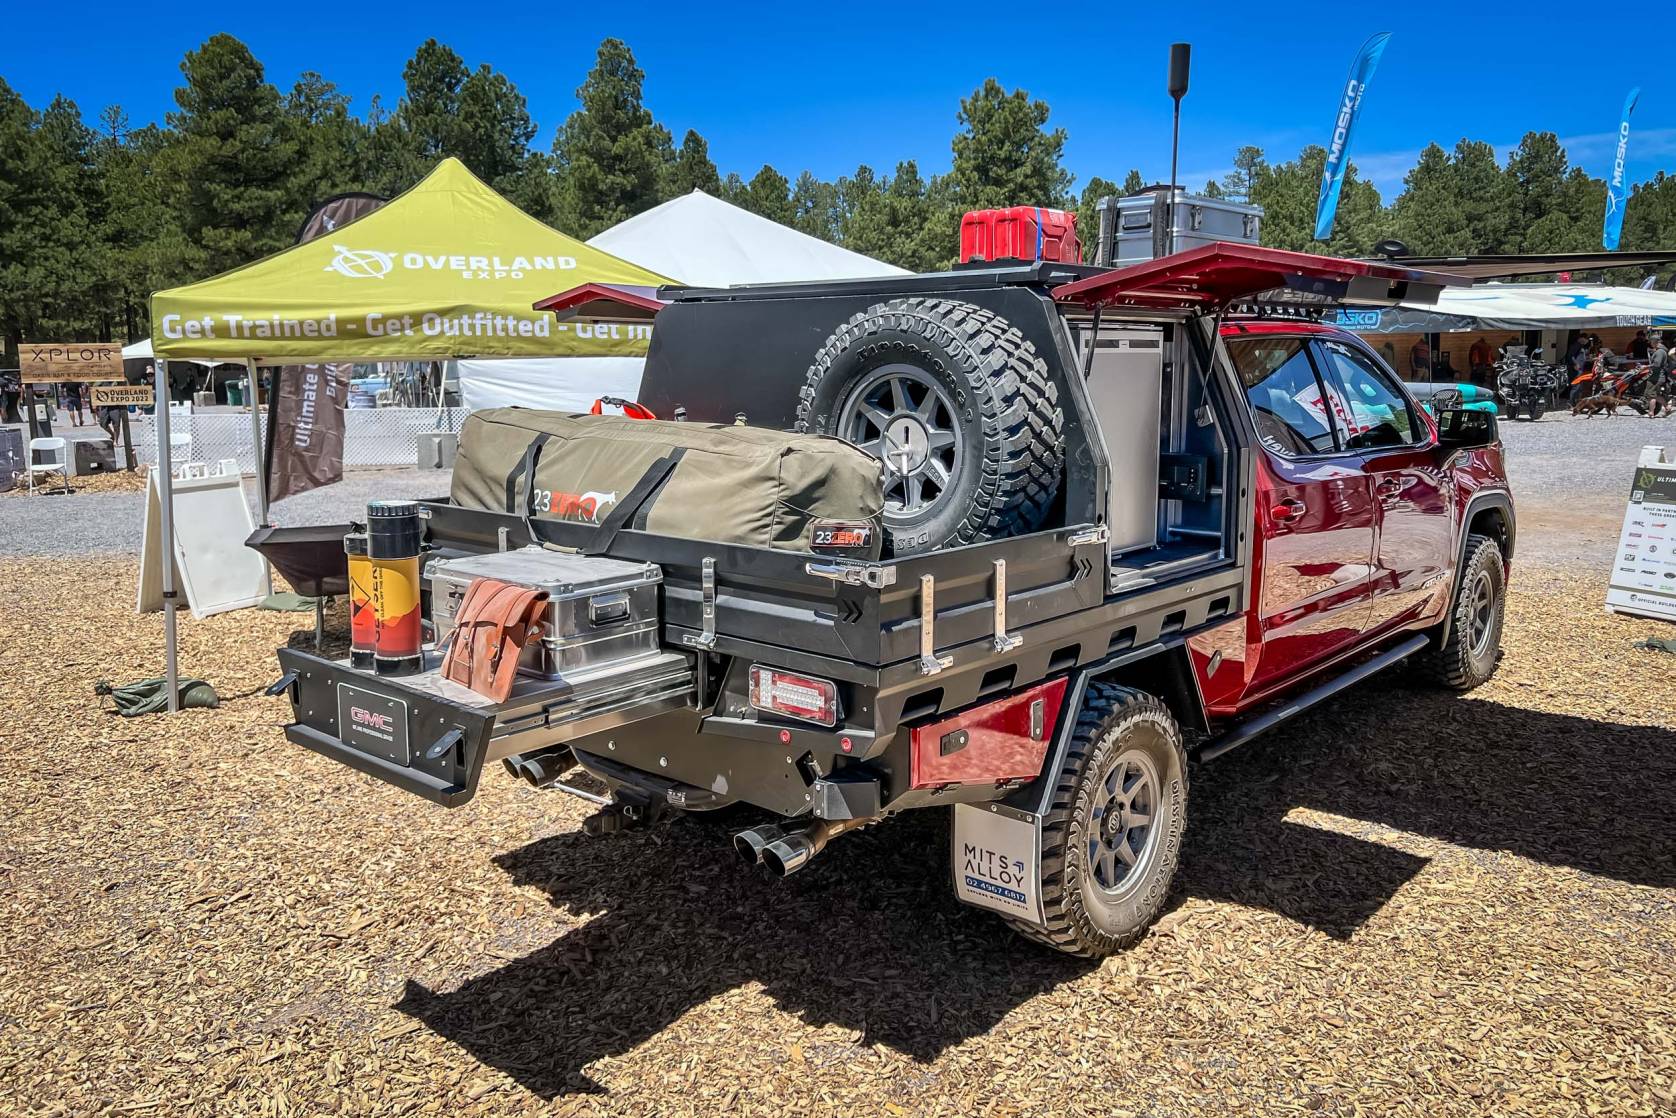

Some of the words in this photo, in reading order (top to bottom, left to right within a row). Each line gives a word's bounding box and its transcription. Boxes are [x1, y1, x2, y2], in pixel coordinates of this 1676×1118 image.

[1328, 79, 1359, 164] MOSKO
[1612, 121, 1630, 187] MOSKO
[403, 253, 577, 270] OVERLAND
[462, 271, 524, 279] EXPO
[162, 314, 216, 339] Get
[222, 313, 337, 337] Trained
[366, 313, 415, 337] Get
[422, 312, 550, 337] Outfitted
[1337, 313, 1377, 325] OSKO
[31, 348, 112, 361] XPLOR
[295, 372, 319, 448] Ultimate
[815, 531, 863, 545] 23ZERO
[350, 706, 393, 732] GMC
[964, 842, 1008, 869] MITS
[965, 859, 1024, 888] ALLOY
[966, 878, 978, 887] 02
[980, 882, 1002, 894] 4967
[1004, 889, 1025, 901] 6817
